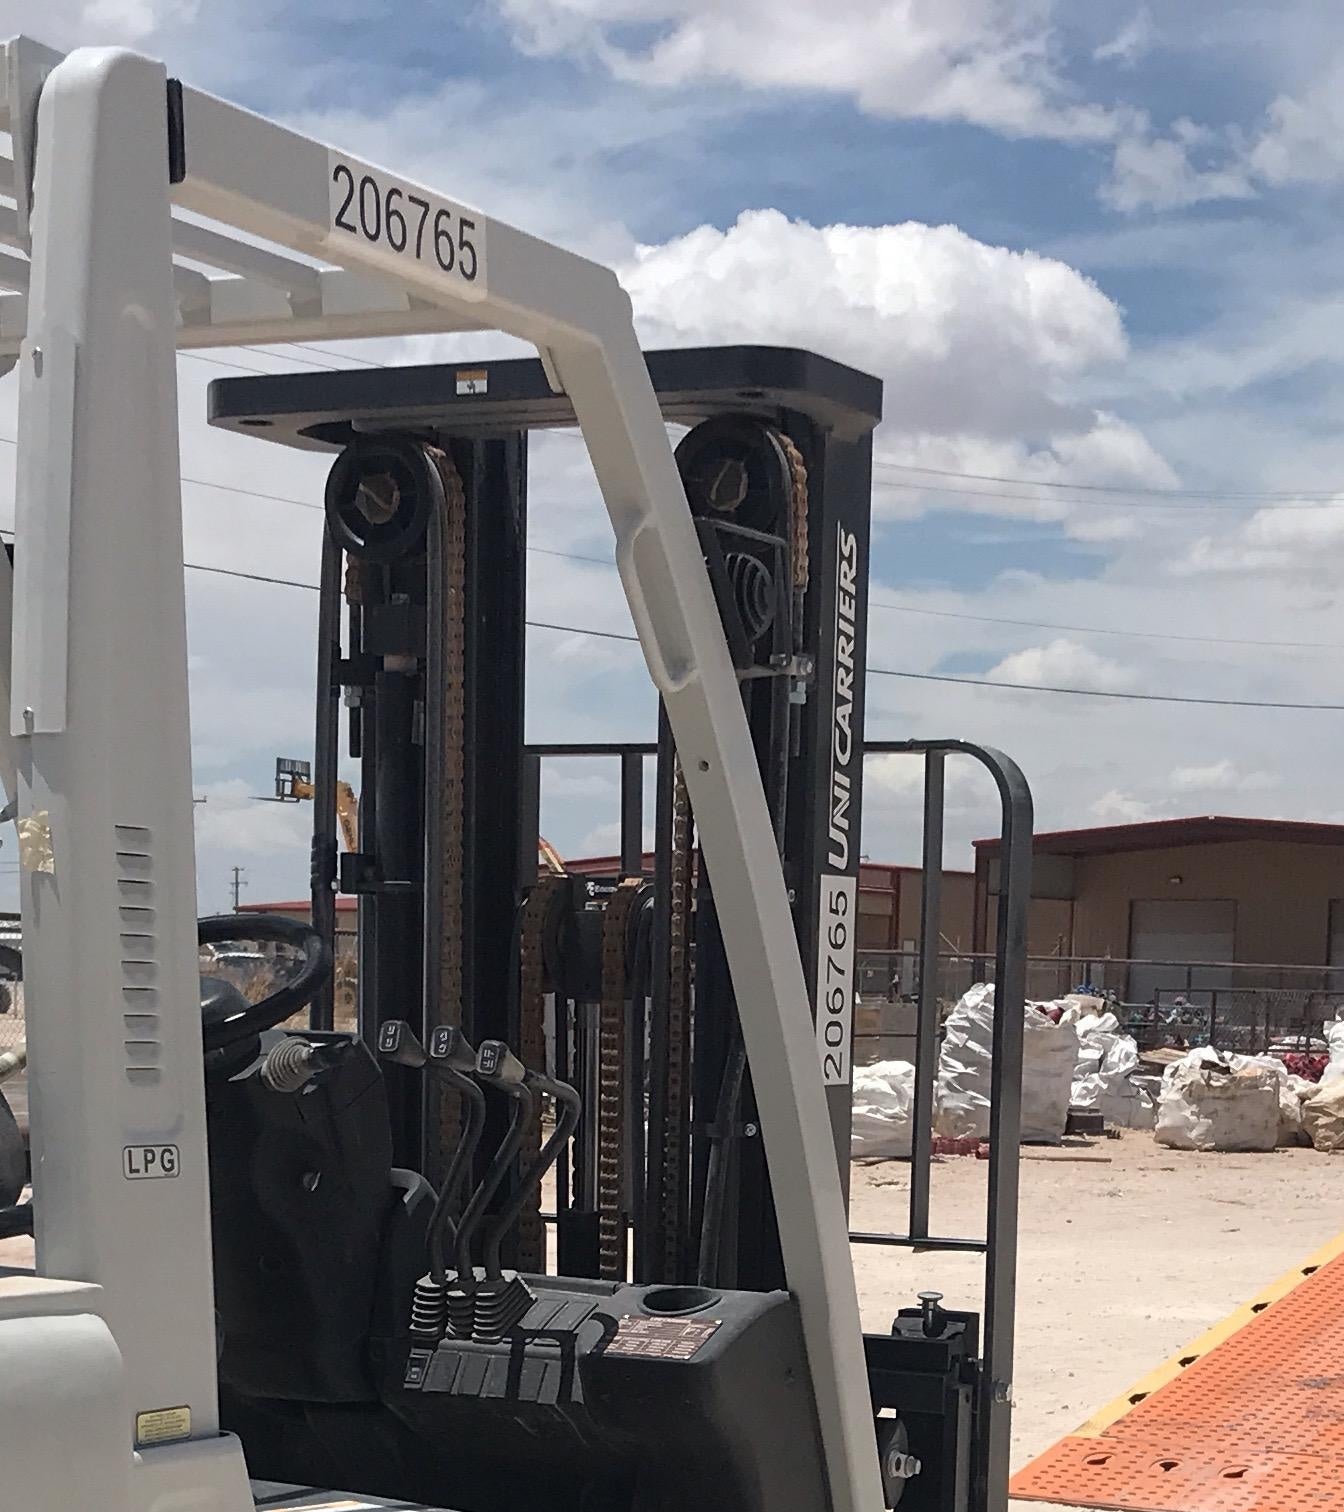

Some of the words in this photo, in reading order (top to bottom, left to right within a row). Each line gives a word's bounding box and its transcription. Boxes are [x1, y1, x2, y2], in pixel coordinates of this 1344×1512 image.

[333, 164, 478, 281] 206765
[824, 890, 848, 1080] 206765
[128, 1148, 175, 1174] LPG
